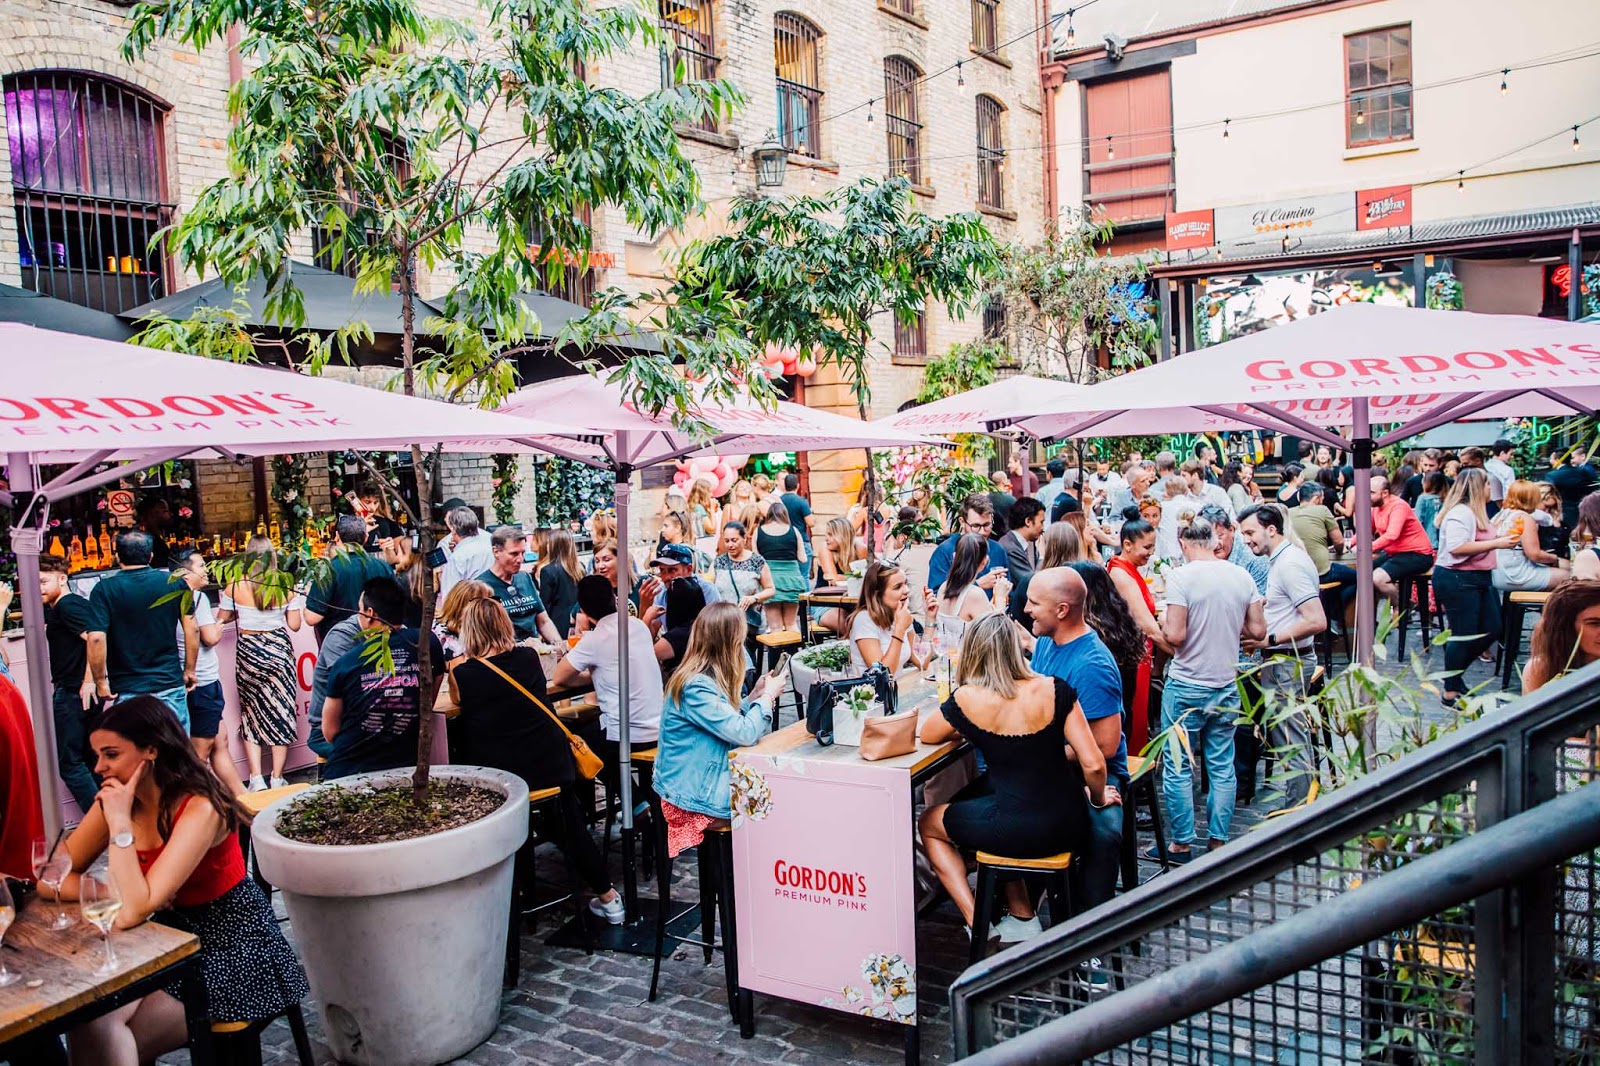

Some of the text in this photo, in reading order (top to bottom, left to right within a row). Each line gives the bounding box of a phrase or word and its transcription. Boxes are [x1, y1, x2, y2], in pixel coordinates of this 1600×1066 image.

[1252, 206, 1315, 226] El Camino
[1245, 343, 1600, 382] GORDON'S
[1250, 367, 1600, 393] PREMIUM PIN
[0, 391, 326, 421] ORDON'S
[12, 418, 353, 435] EMIUM PINK
[774, 859, 867, 897] GORDON'S
[774, 888, 867, 911] PREMIUM PINK
